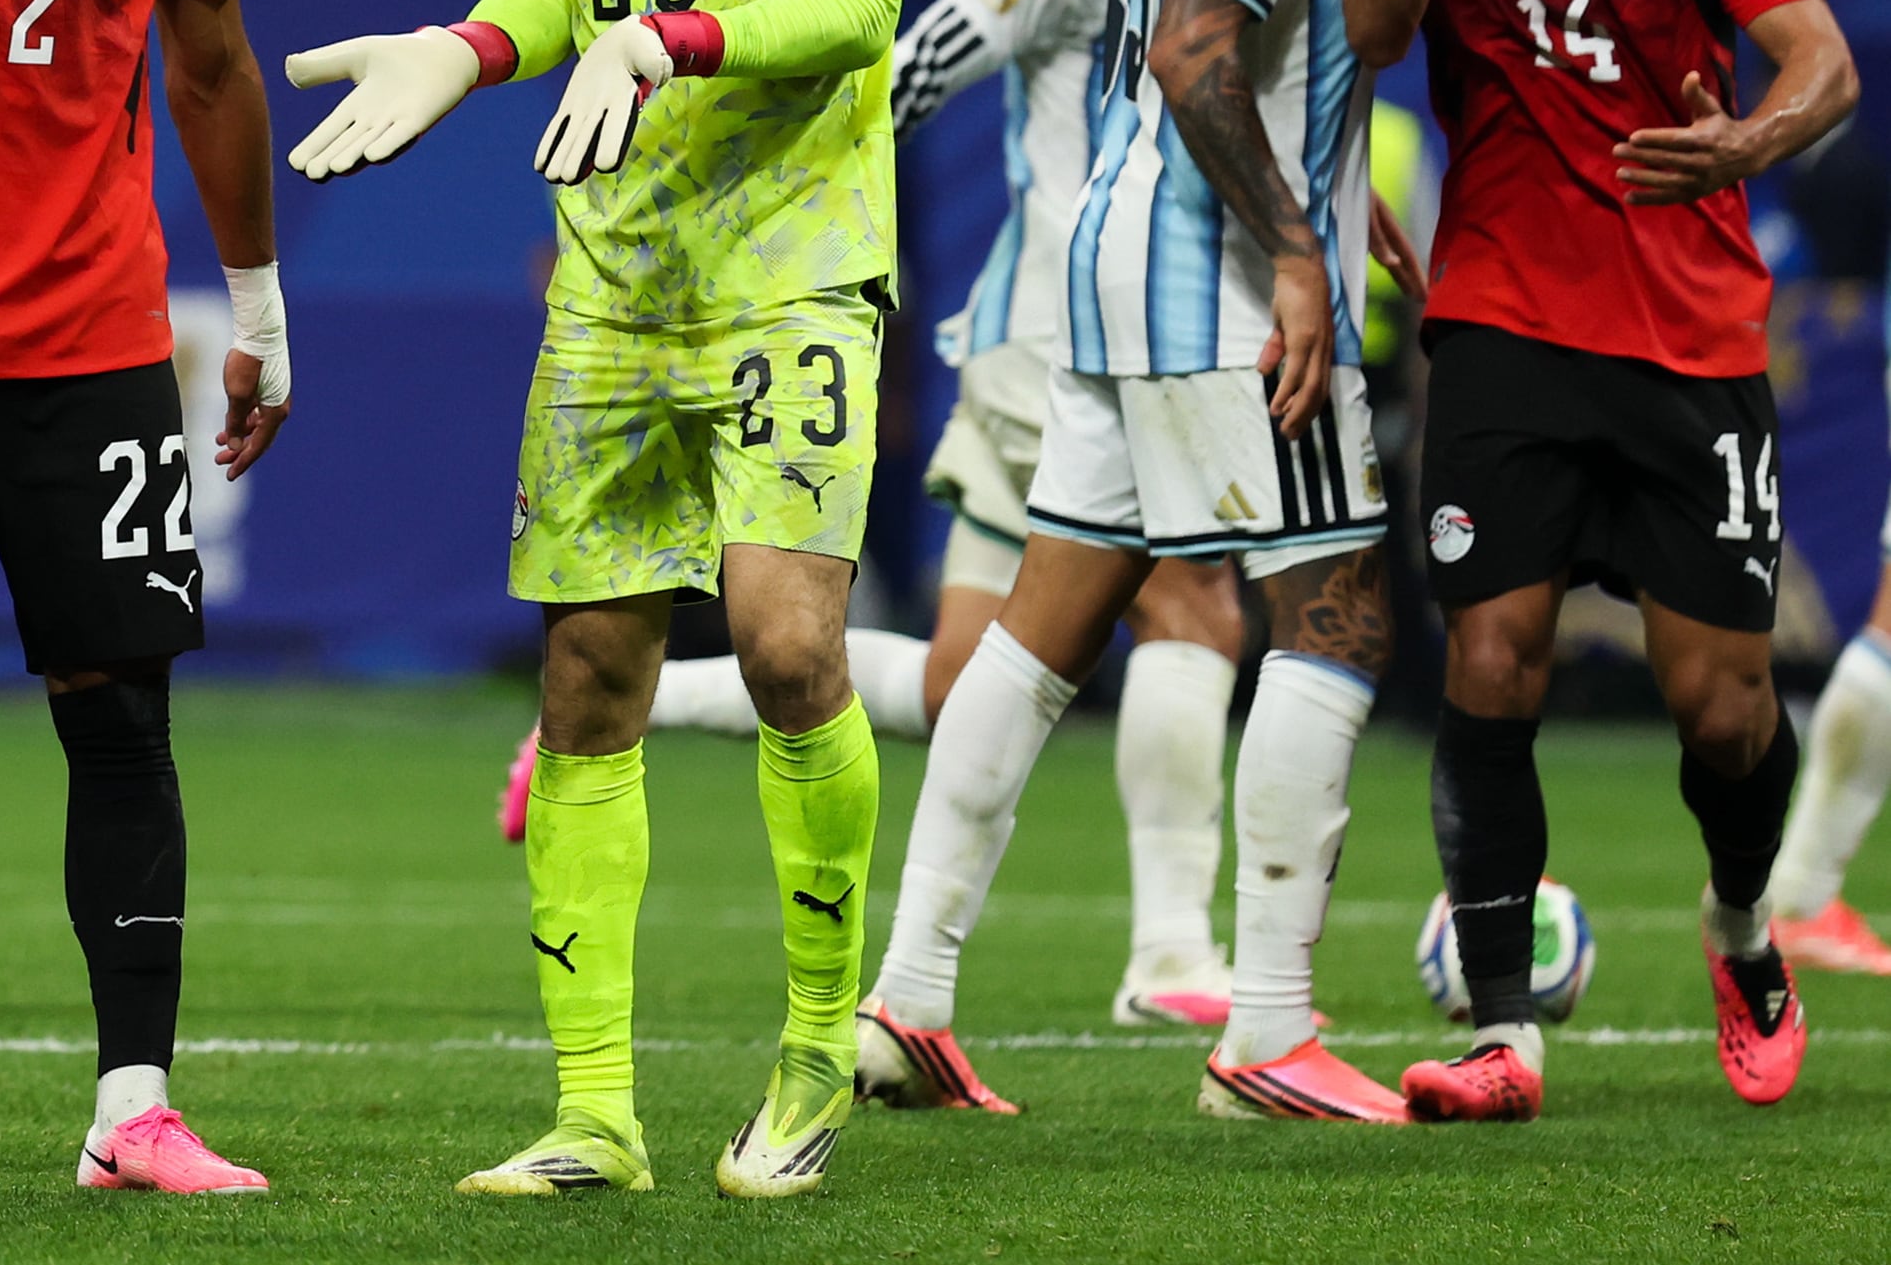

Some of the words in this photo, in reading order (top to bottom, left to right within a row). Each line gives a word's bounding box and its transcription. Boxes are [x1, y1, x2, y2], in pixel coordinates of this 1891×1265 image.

[731, 344, 847, 448] 23
[99, 434, 196, 560] 22
[1712, 432, 1781, 542] 14
